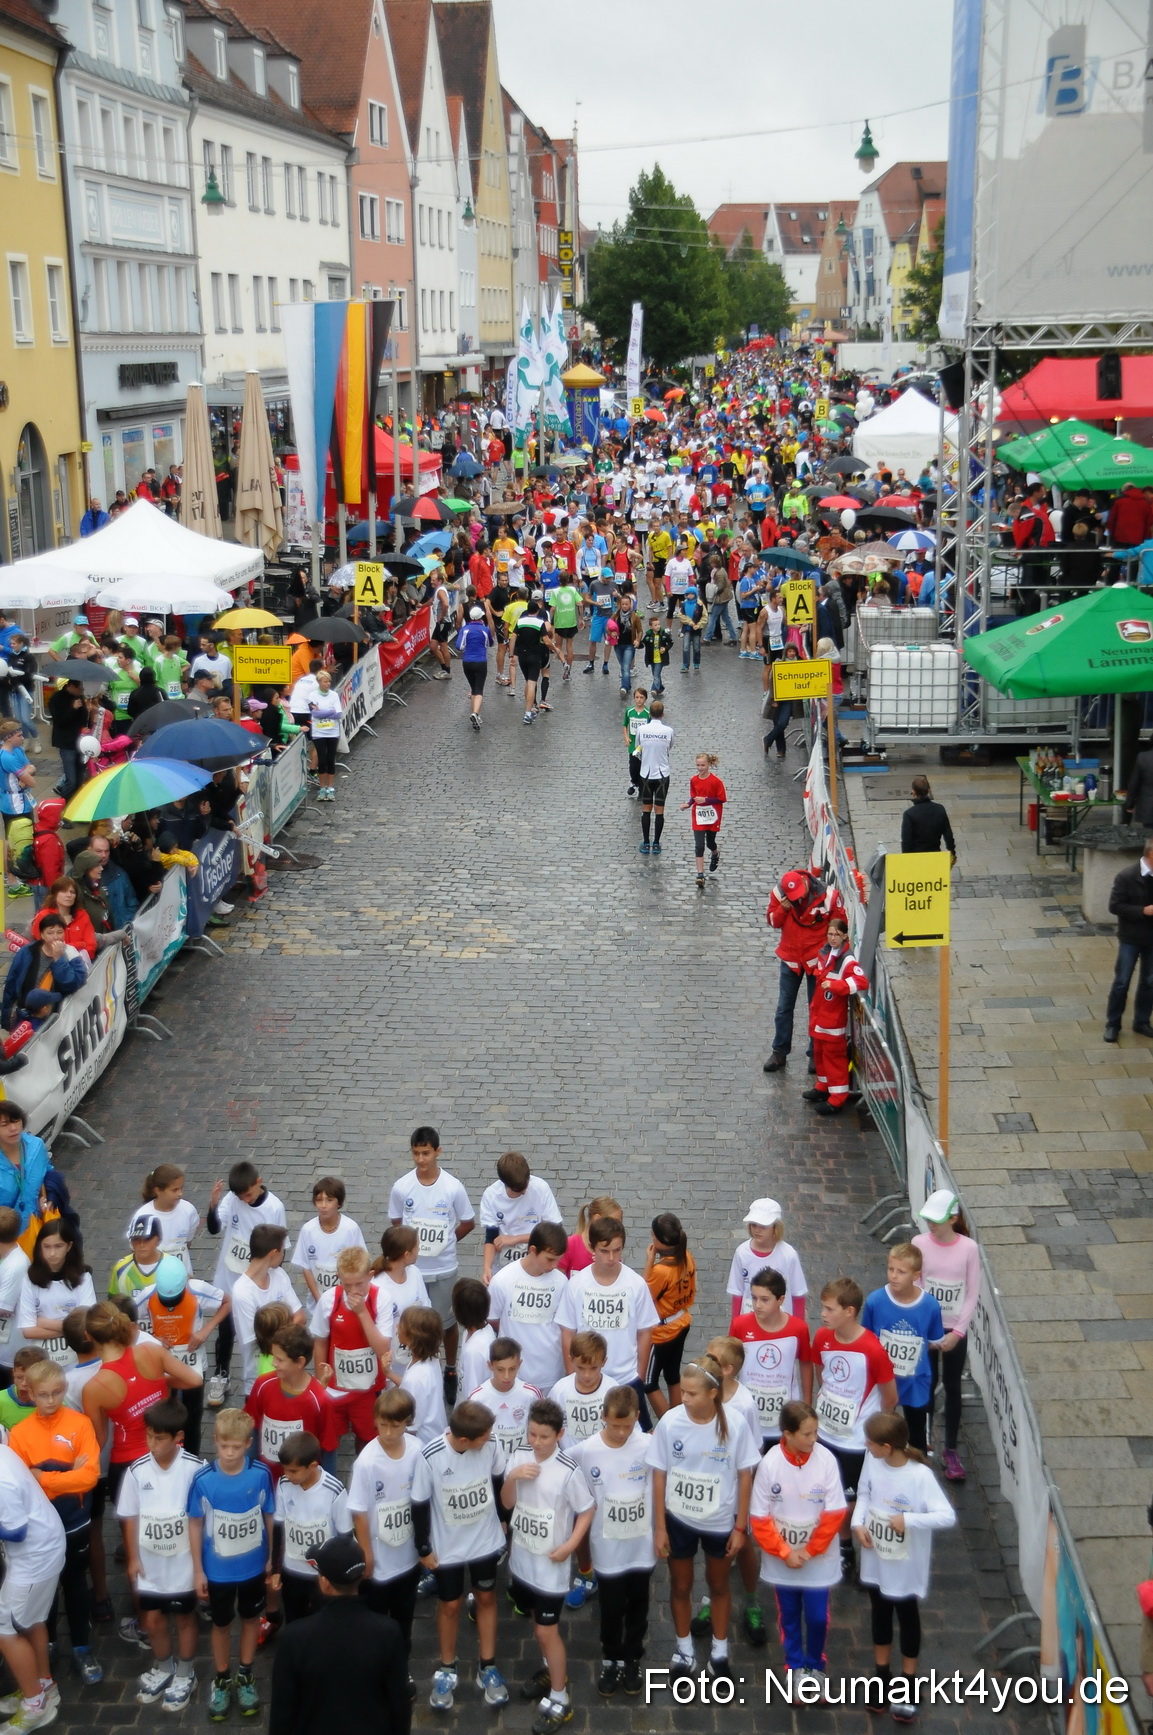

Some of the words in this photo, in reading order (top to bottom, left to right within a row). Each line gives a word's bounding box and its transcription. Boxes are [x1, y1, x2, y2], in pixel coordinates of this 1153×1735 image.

[559, 232, 573, 309] HOTEL
[634, 403, 641, 414] B
[818, 405, 826, 415] B
[358, 564, 381, 573] Block
[88, 574, 105, 583] für
[360, 576, 377, 596] A
[789, 582, 812, 591] Block
[793, 594, 810, 614] A
[238, 656, 288, 666] Schnupper-
[254, 667, 271, 675] lauf
[777, 671, 827, 682] Schnupper-
[794, 681, 811, 690] lauf
[697, 810, 716, 818] 4016
[206, 849, 235, 894] Fischer
[887, 878, 948, 897] Jugend-
[904, 894, 932, 911] lauf
[231, 1244, 252, 1263] 404
[317, 1273, 340, 1287] 402
[516, 1291, 552, 1309] 4053
[929, 1286, 961, 1303] 4007
[587, 1298, 624, 1315] 4054
[587, 1314, 620, 1329] Patrick
[51, 1354, 69, 1362] Linda
[883, 1341, 917, 1361] 4032
[338, 1357, 374, 1374] 4050
[756, 1395, 784, 1412] 033
[819, 1400, 850, 1425] 4029
[447, 1486, 489, 1510] 4008
[674, 1480, 714, 1502] 4031
[453, 1508, 485, 1520] Sebastian
[607, 1501, 645, 1523] 4056
[681, 1502, 704, 1513] Teresa
[384, 1508, 411, 1530] 406
[513, 1514, 549, 1538] 4055
[144, 1520, 184, 1540] 4038
[218, 1518, 258, 1540] 4059
[289, 1526, 326, 1547] 4030
[153, 1542, 177, 1554] Philipp
